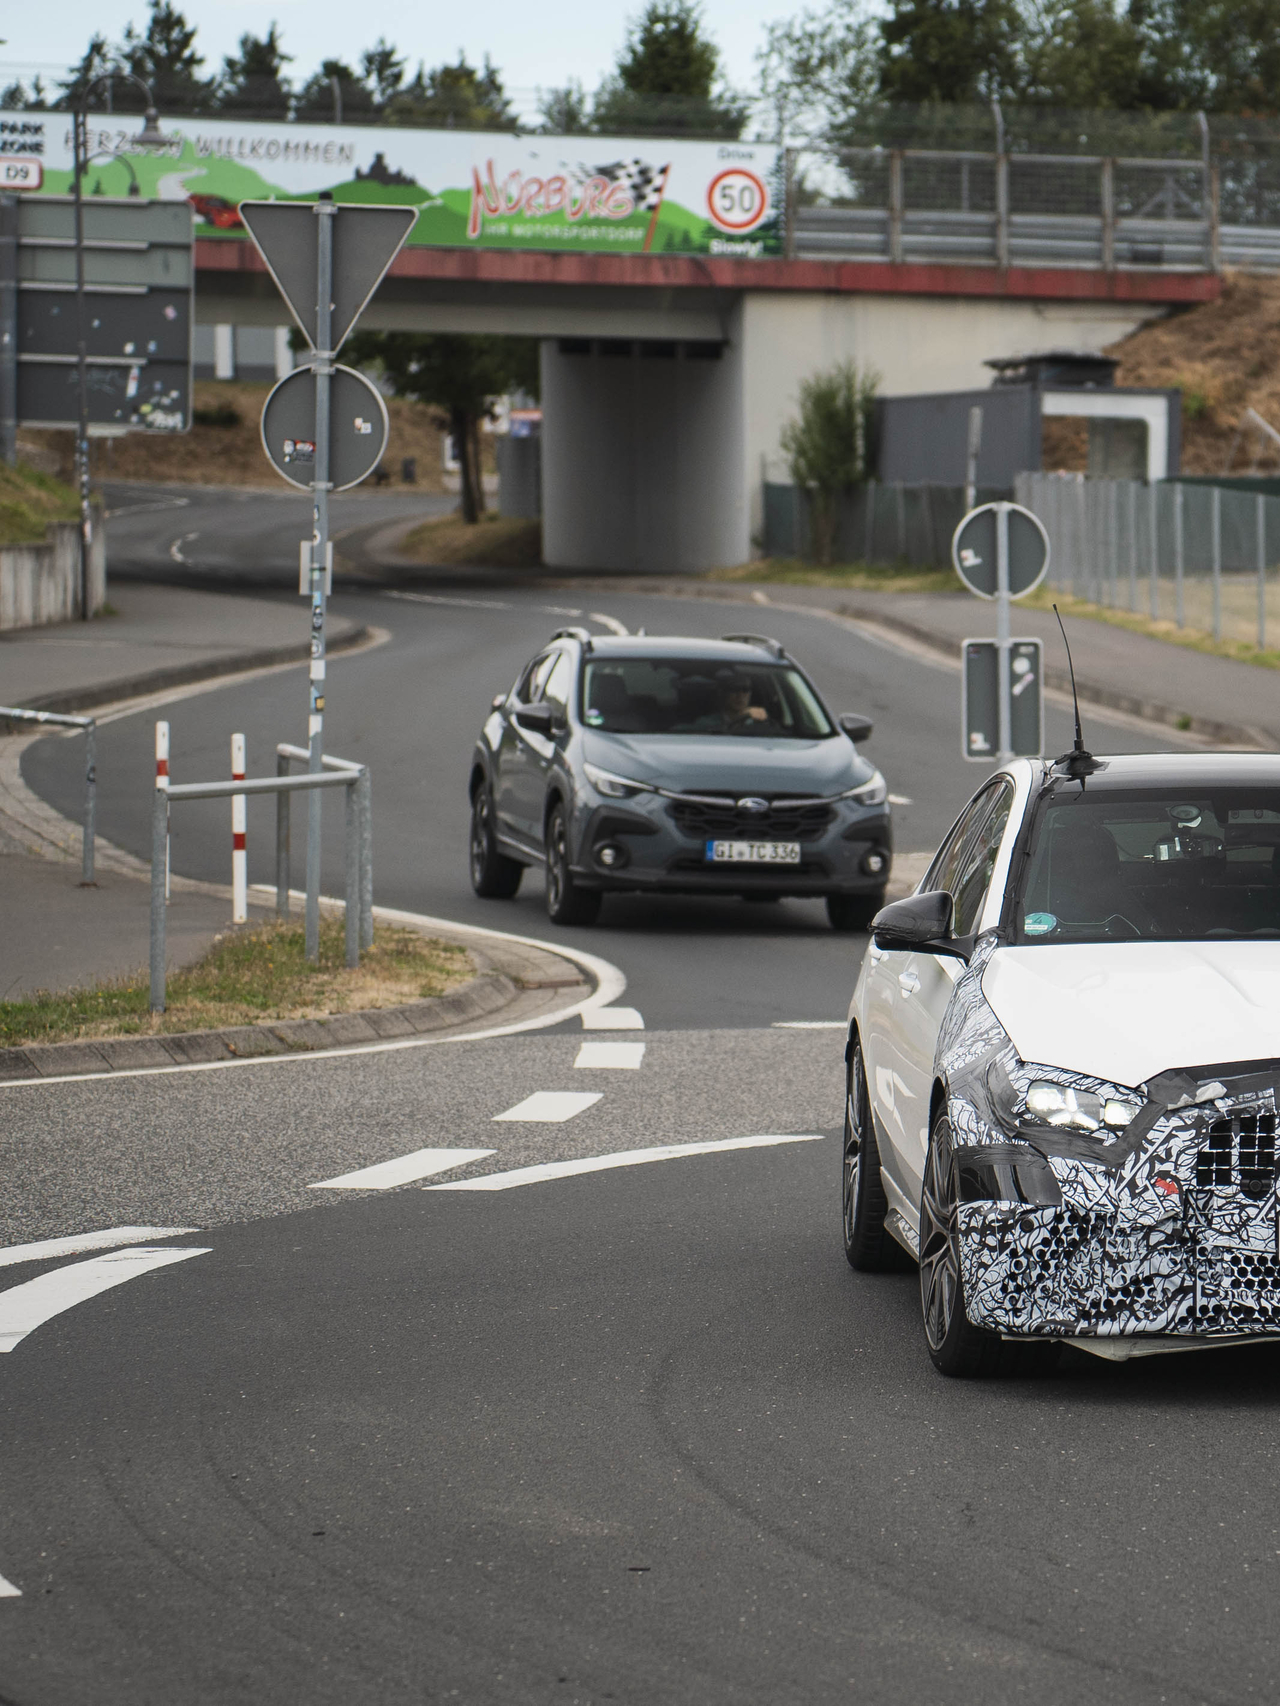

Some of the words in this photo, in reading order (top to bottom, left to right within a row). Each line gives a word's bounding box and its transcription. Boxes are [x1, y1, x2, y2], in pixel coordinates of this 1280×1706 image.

[195, 134, 354, 163] WILLKOMMEN
[718, 146, 755, 159] Drive
[721, 184, 756, 213] 50
[715, 843, 734, 859] GI
[747, 844, 766, 860] TC
[769, 844, 799, 860] 336
